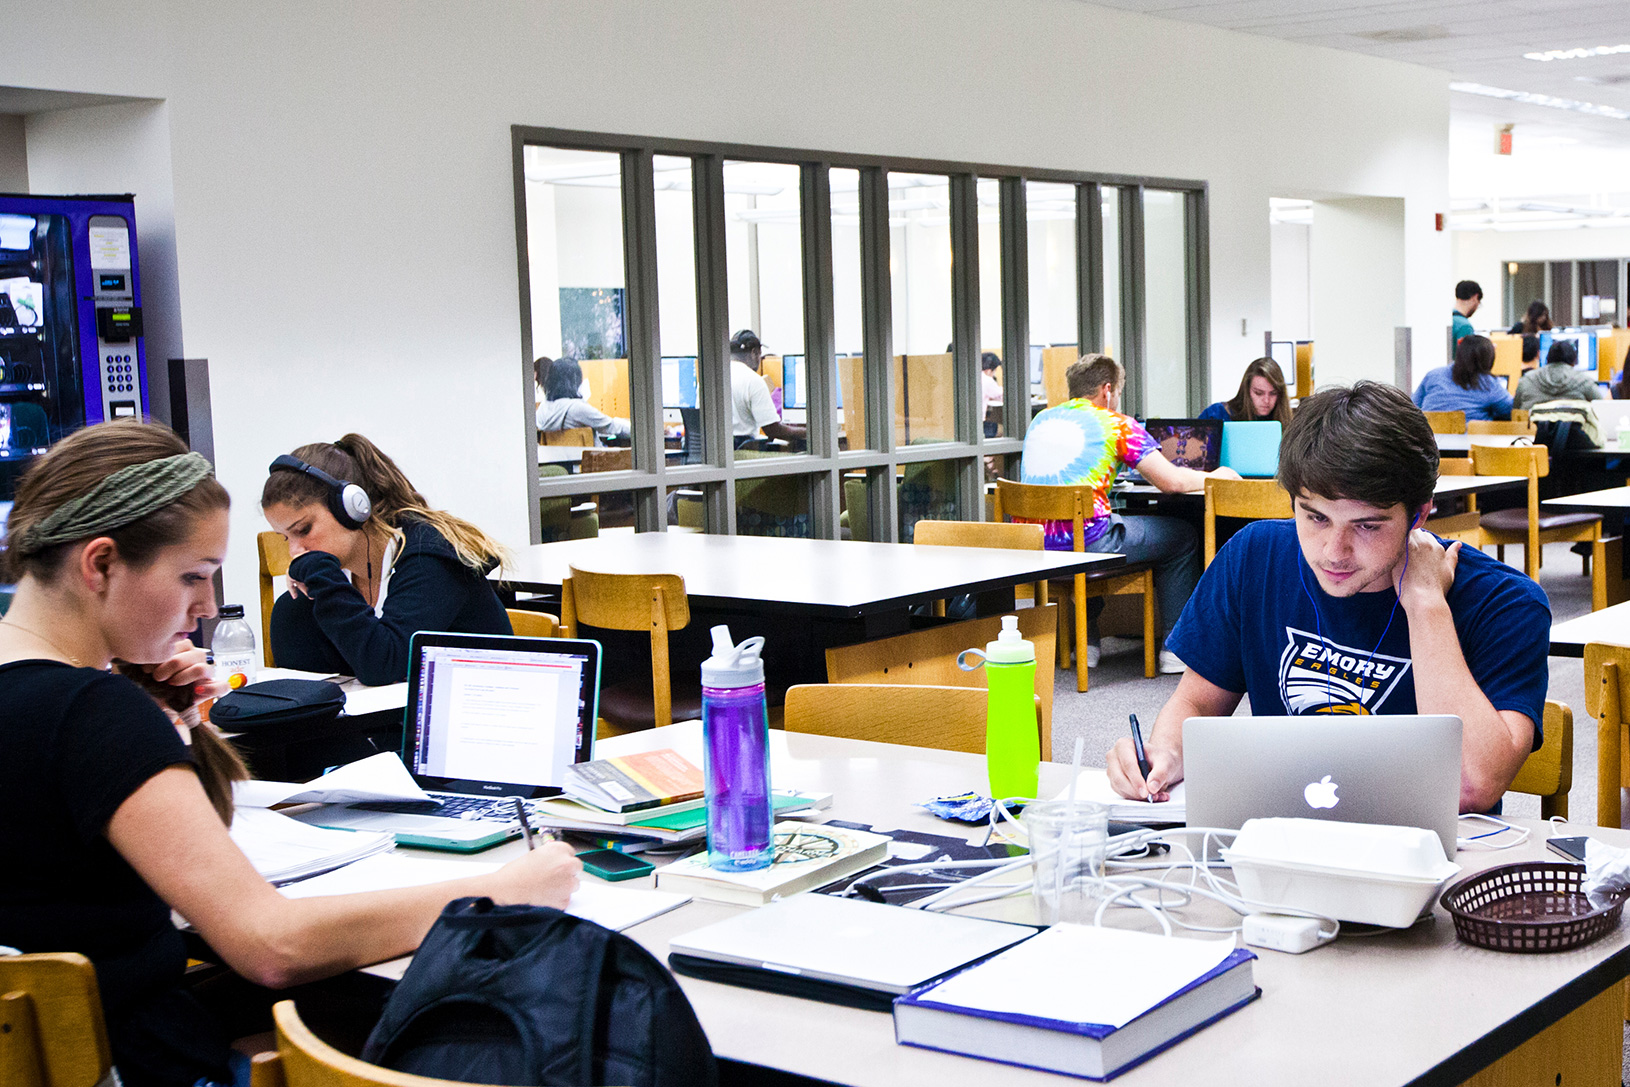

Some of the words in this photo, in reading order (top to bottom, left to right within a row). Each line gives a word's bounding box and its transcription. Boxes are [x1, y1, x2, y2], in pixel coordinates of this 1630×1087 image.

[221, 658, 250, 667] HONEST
[1294, 658, 1381, 689] EAGLES
[1300, 642, 1396, 680] EMORY
